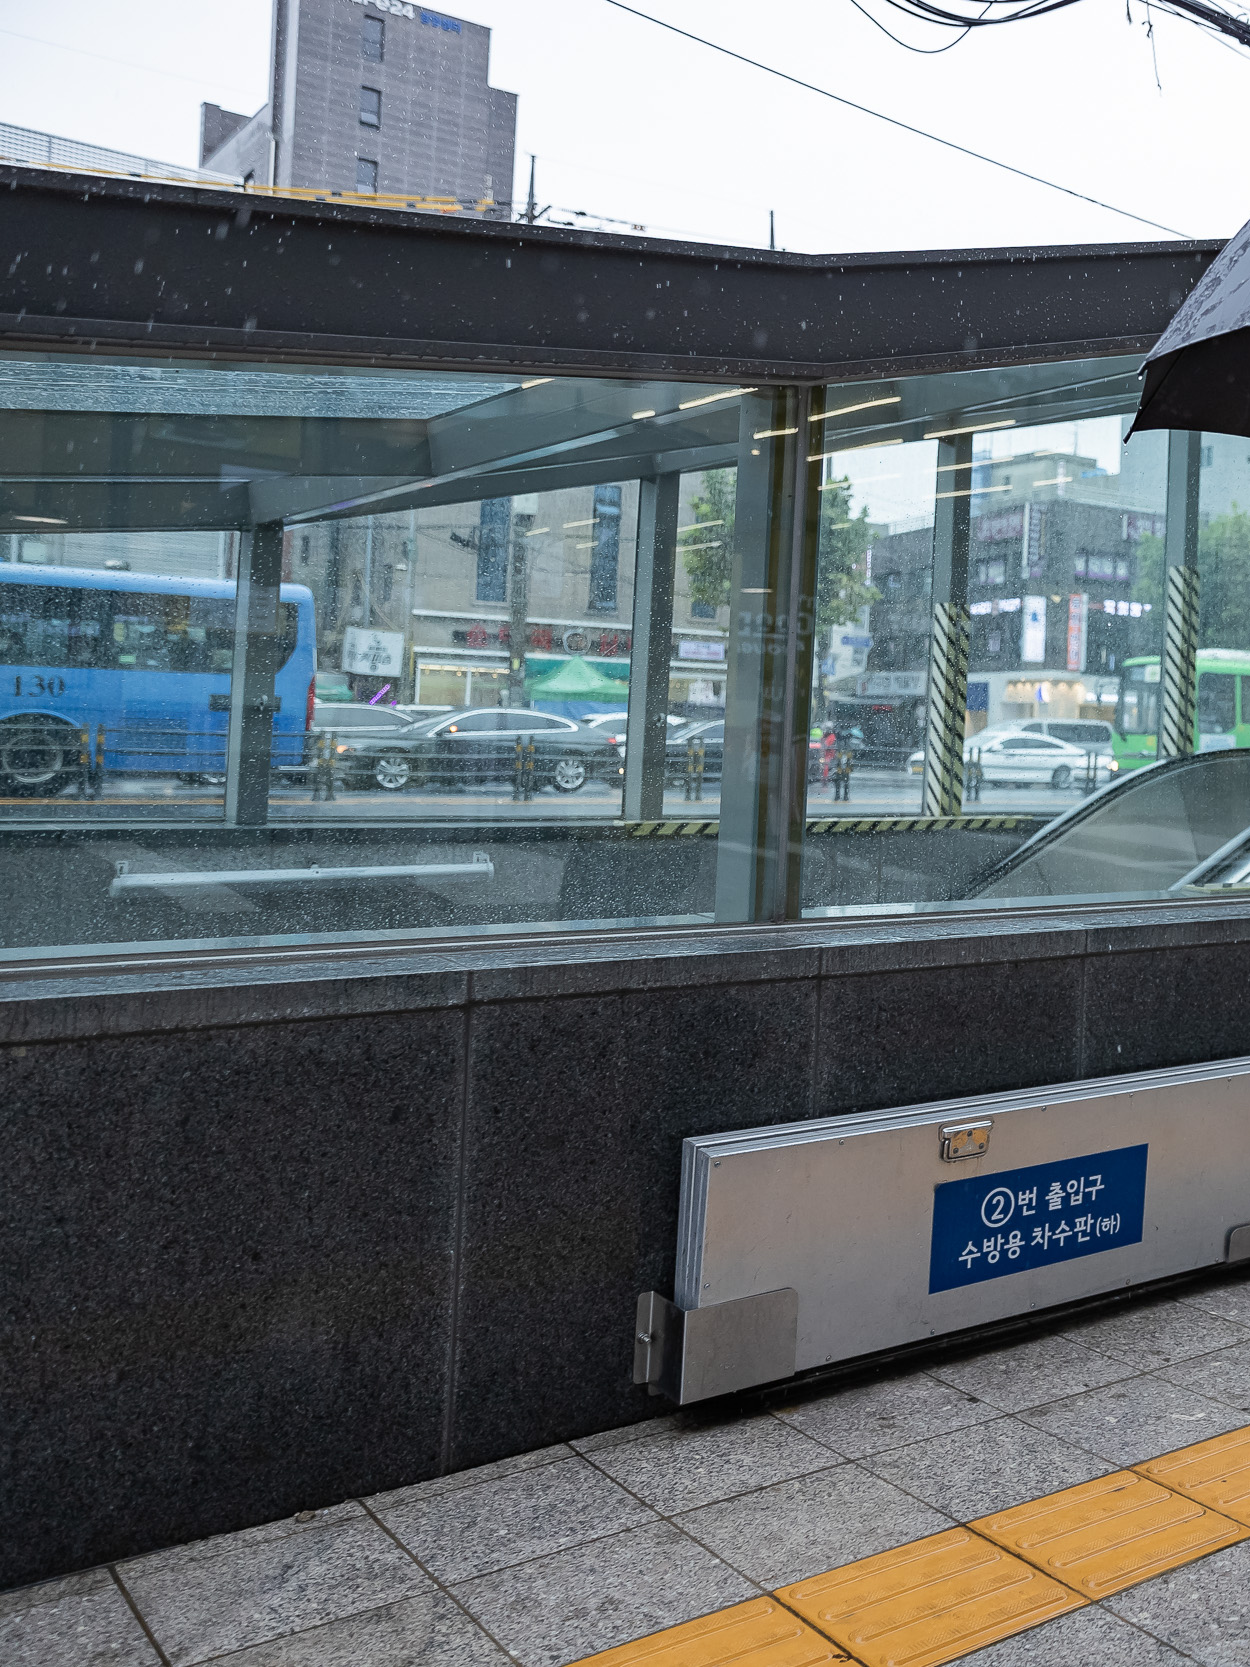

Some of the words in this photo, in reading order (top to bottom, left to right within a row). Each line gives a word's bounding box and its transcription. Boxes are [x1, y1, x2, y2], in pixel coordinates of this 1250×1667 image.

[13, 674, 66, 698] 130
[1045, 1173, 1105, 1212] 출입구
[957, 1230, 1026, 1270] 수방용
